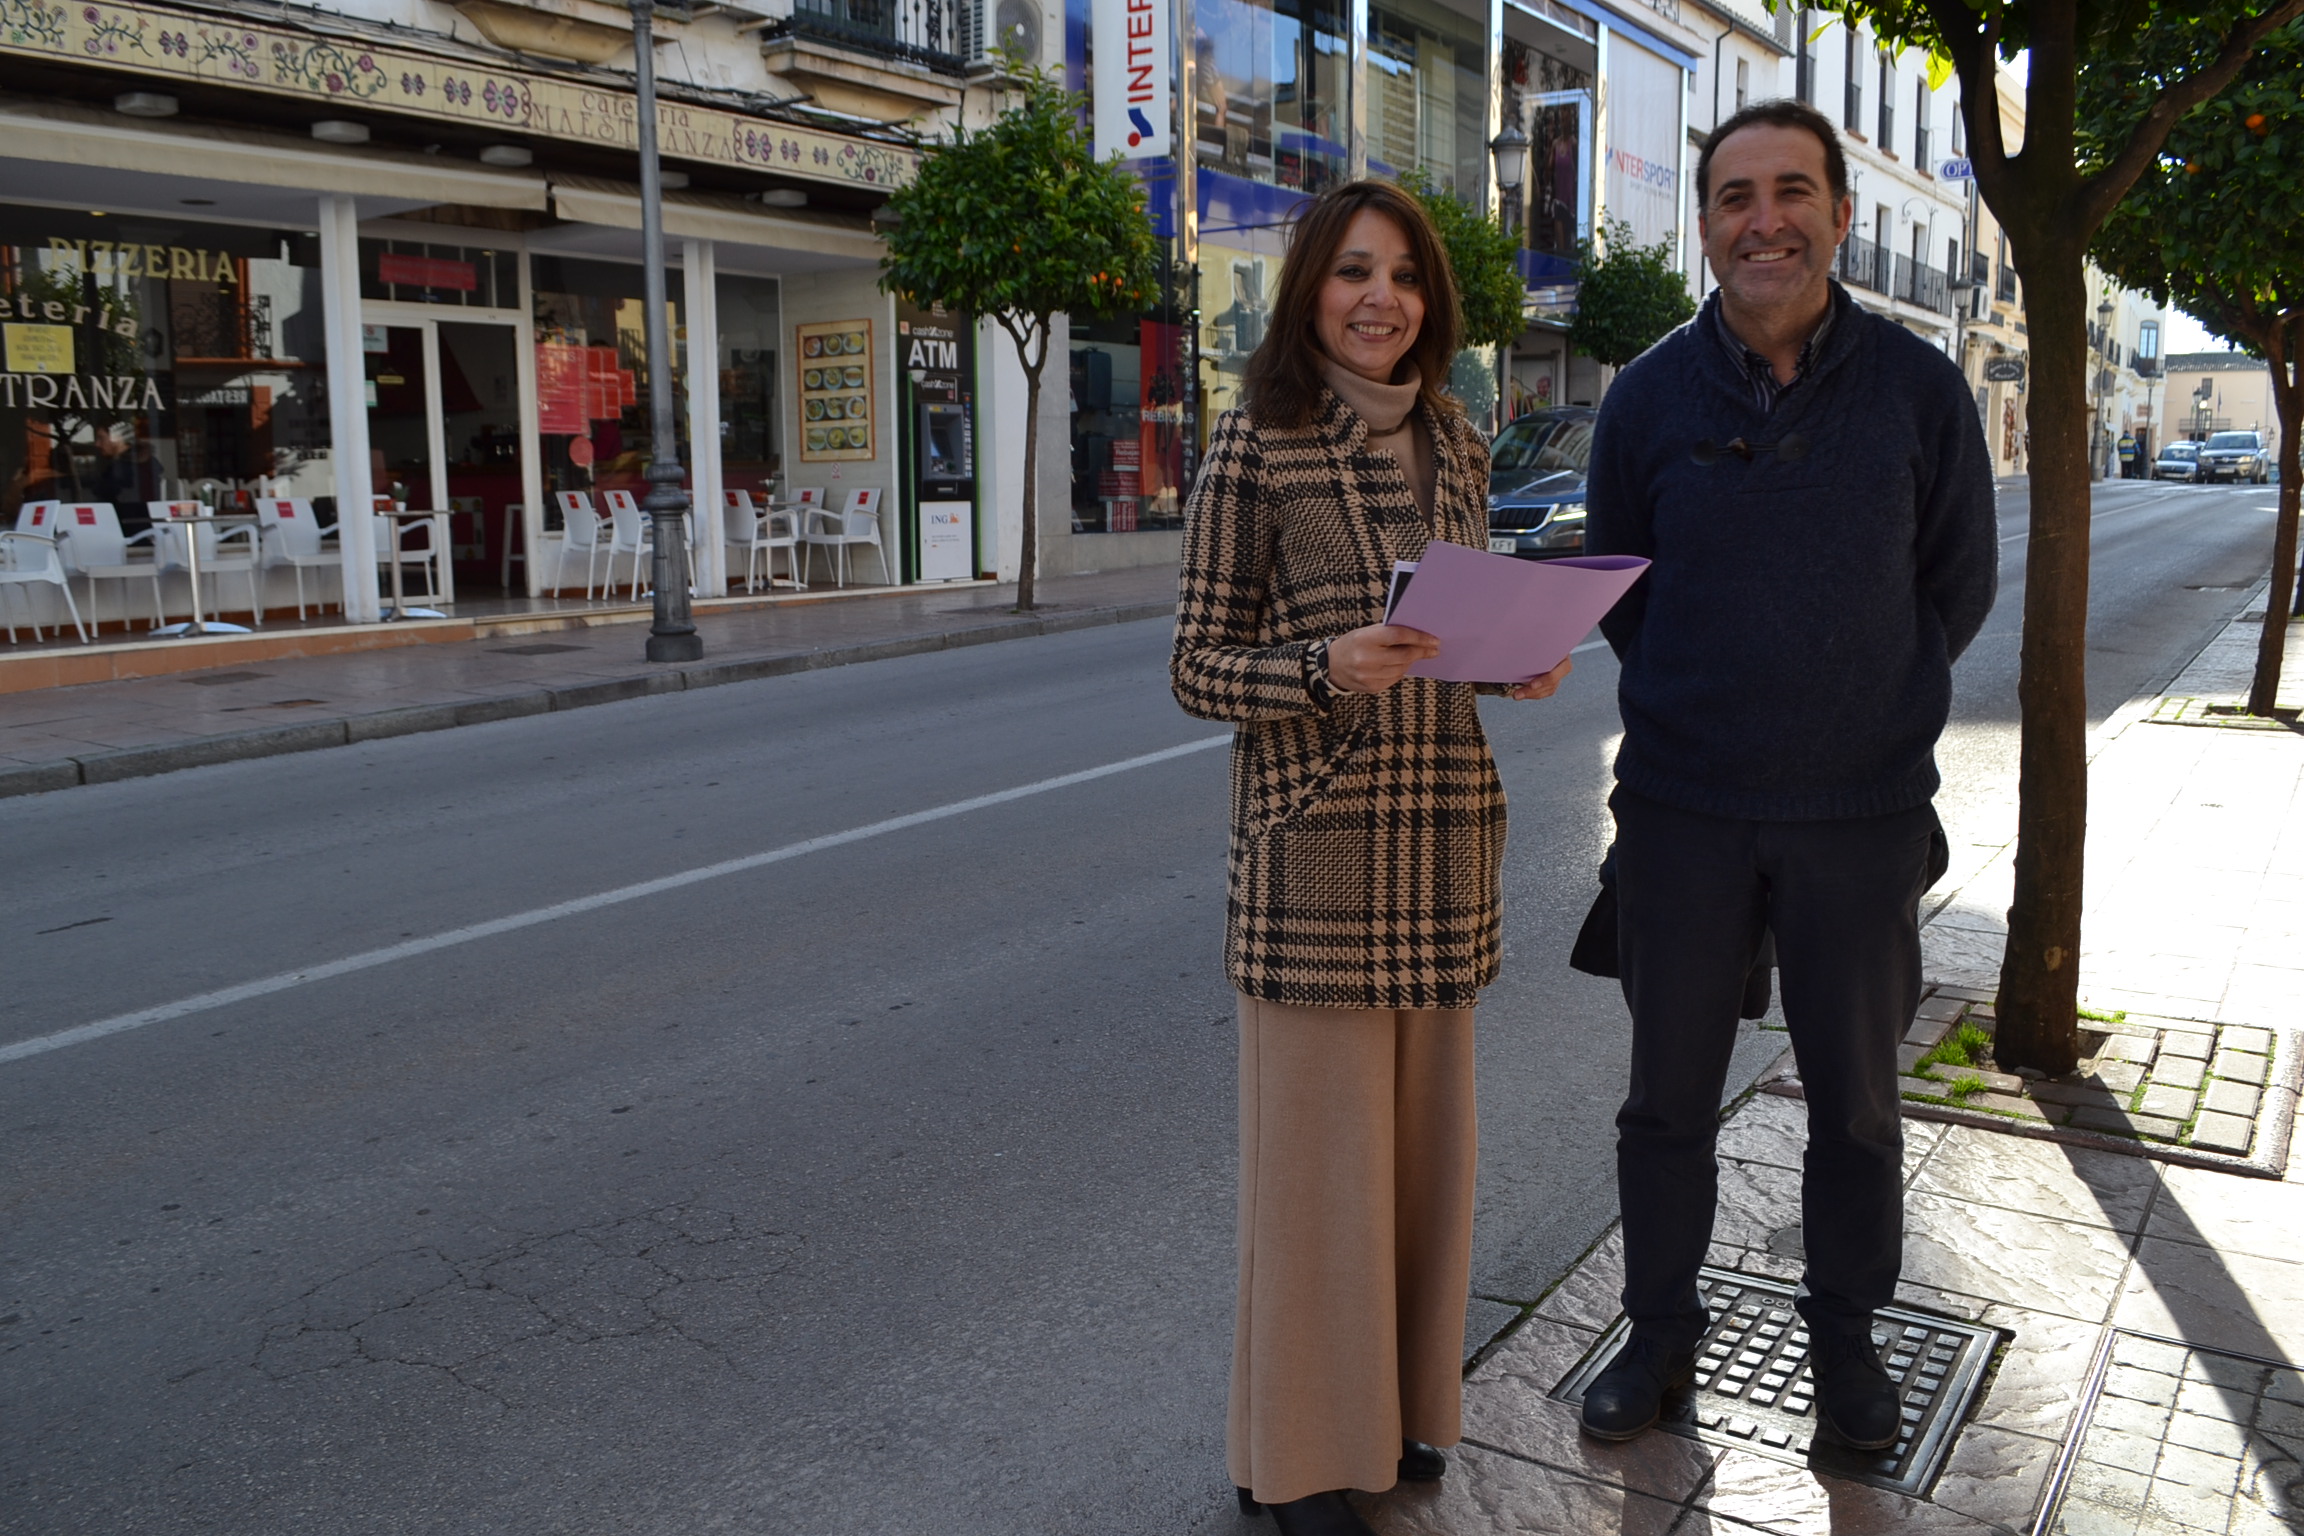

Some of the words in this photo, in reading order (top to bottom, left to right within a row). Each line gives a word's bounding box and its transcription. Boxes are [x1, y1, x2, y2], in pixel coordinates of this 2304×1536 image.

[582, 91, 690, 127] Caferia
[533, 103, 734, 159] MAESTANZA
[1945, 160, 1972, 177] OPT
[48, 237, 238, 283] PIZZERIA
[908, 338, 957, 369] ATM
[0, 373, 165, 411] TRANZA
[931, 514, 948, 525] ING
